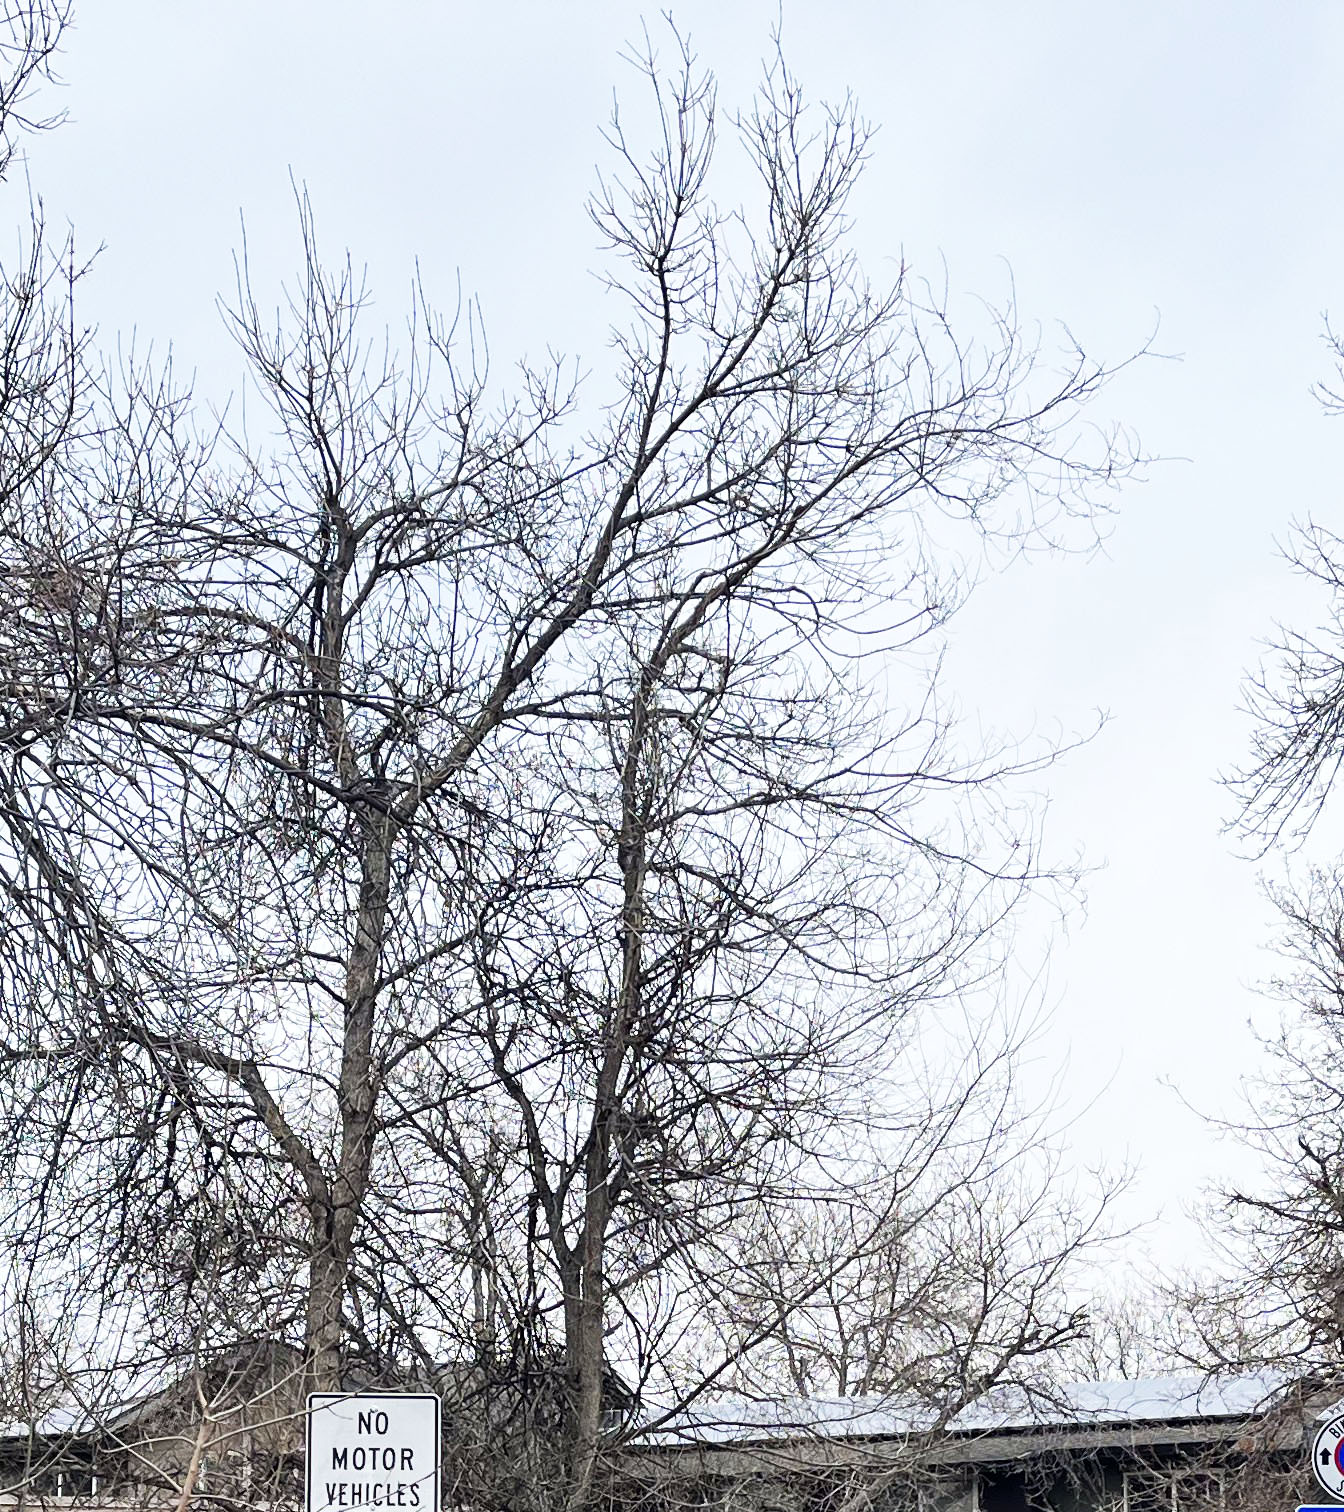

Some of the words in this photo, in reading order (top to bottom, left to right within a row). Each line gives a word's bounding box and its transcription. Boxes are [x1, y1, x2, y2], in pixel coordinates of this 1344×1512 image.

[358, 1412, 388, 1435] NO
[332, 1447, 414, 1471] MOTOR
[326, 1483, 420, 1506] VEHICLES
